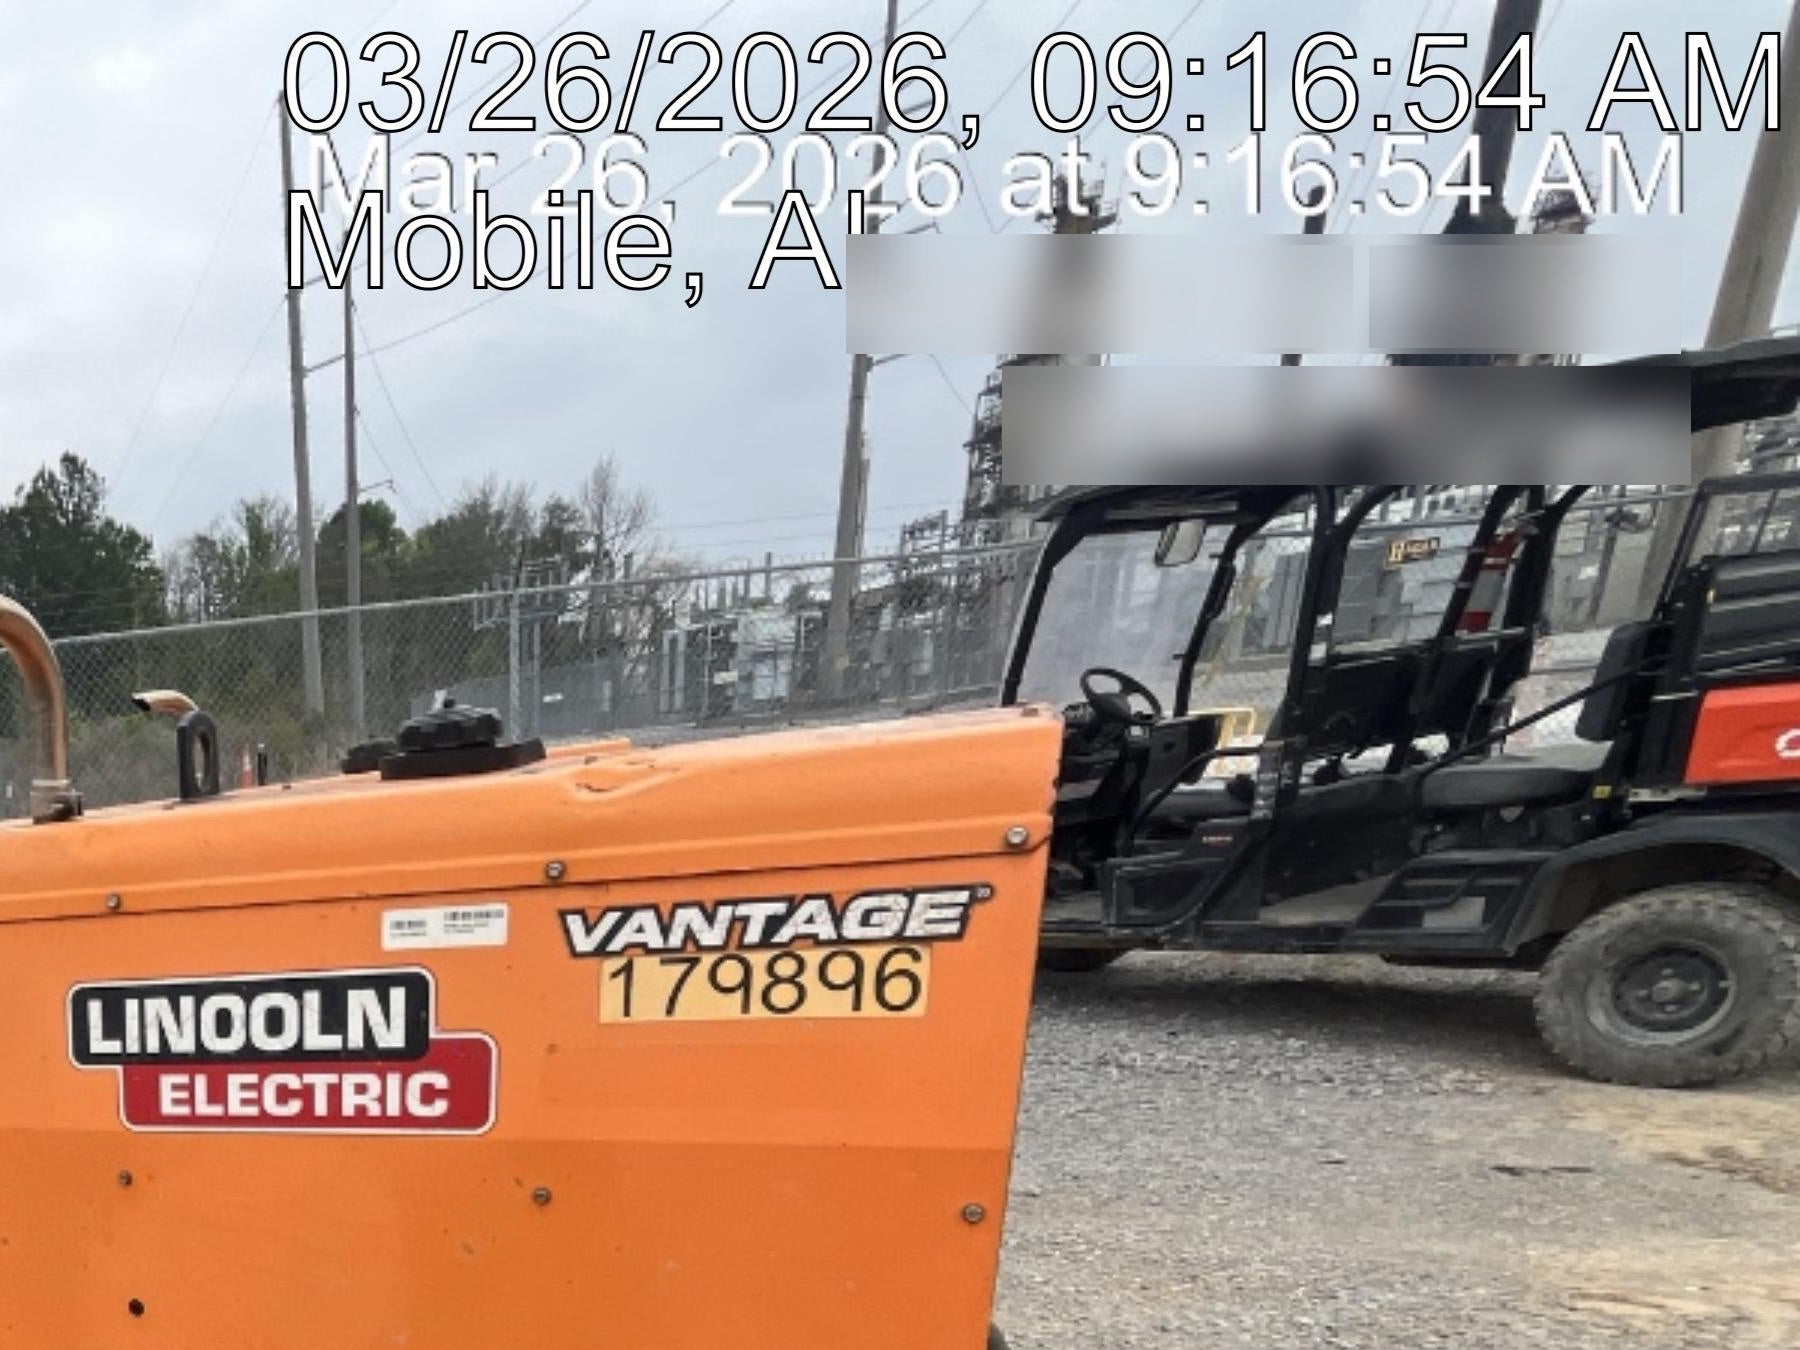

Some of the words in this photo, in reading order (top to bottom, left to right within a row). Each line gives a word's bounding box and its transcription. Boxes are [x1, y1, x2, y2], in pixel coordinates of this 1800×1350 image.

[564, 890, 971, 954] VANTAGE
[609, 945, 924, 1018] 179896
[158, 1071, 450, 1118] ELECTRIC
